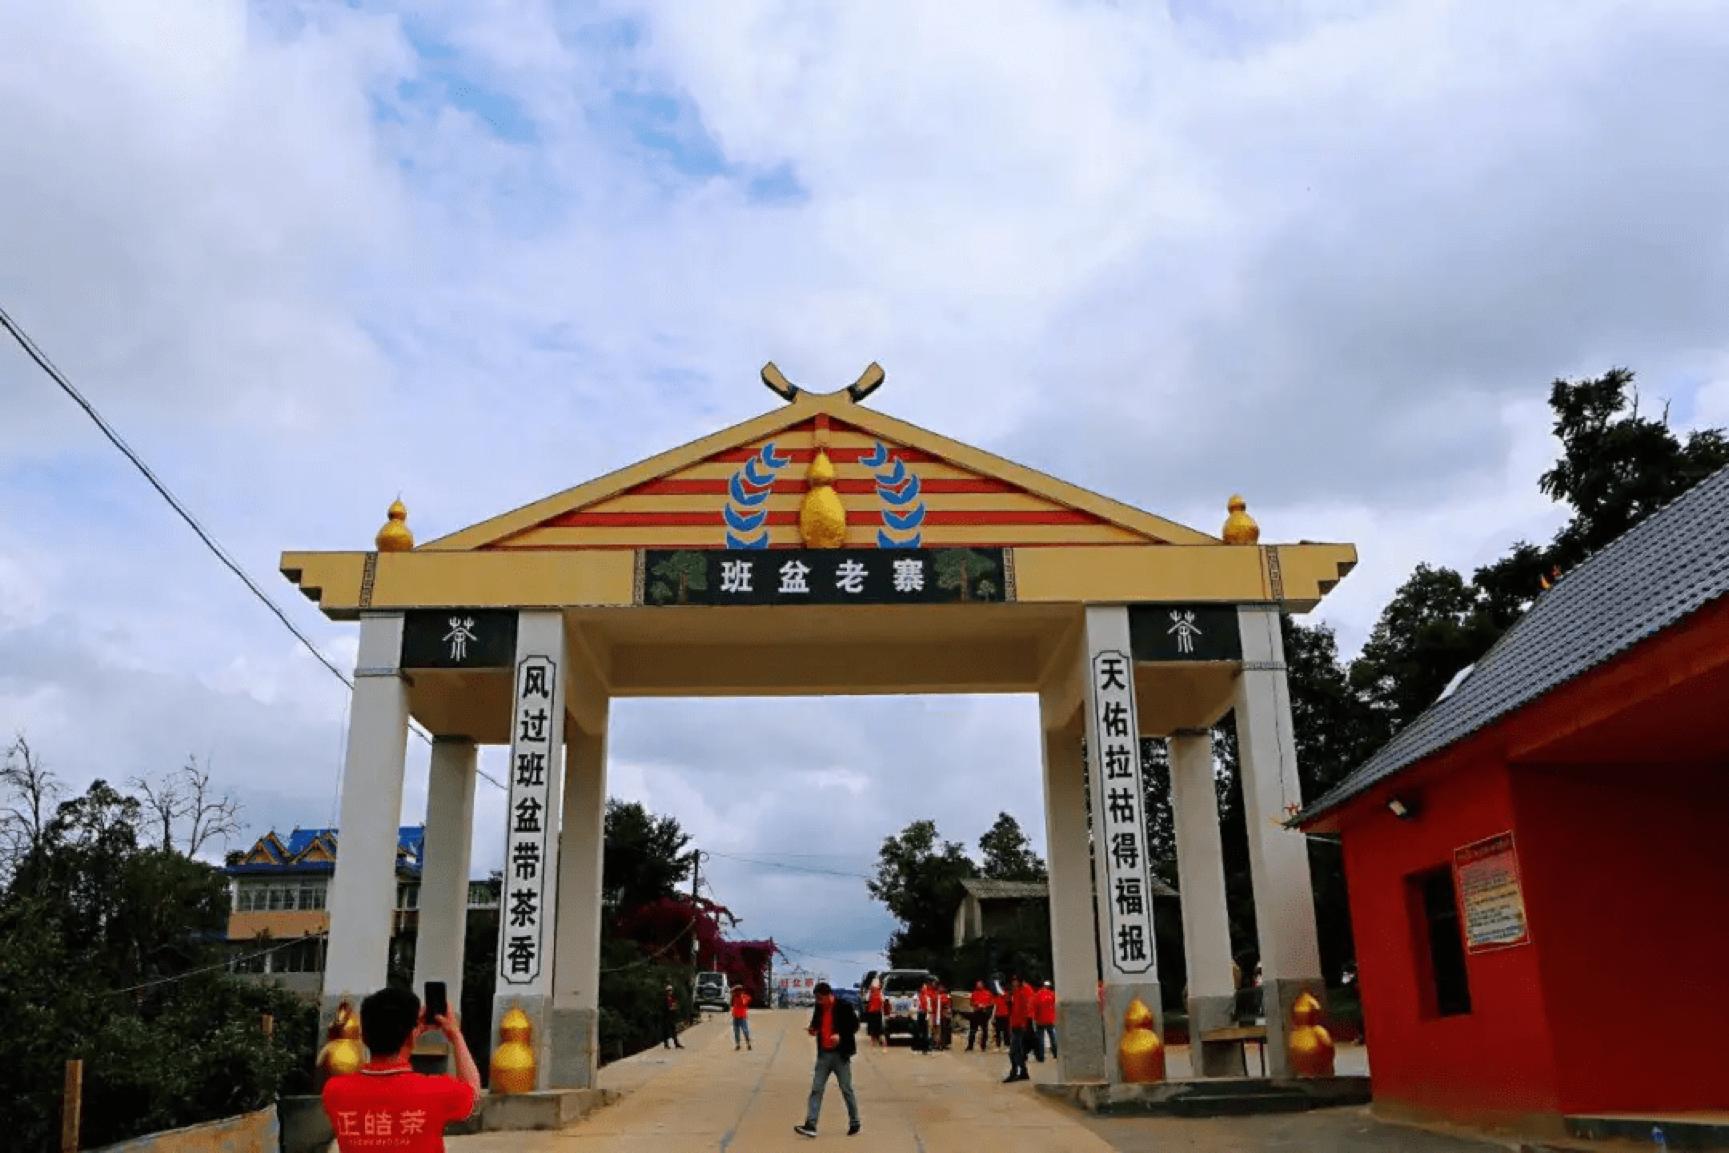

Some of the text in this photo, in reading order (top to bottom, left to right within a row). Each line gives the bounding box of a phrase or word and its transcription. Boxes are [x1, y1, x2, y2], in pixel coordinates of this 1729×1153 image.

[720, 559, 925, 594] 班盆老寨
[507, 665, 549, 975] 风过班盆带茶香
[337, 1109, 426, 1136] 正皓茶
